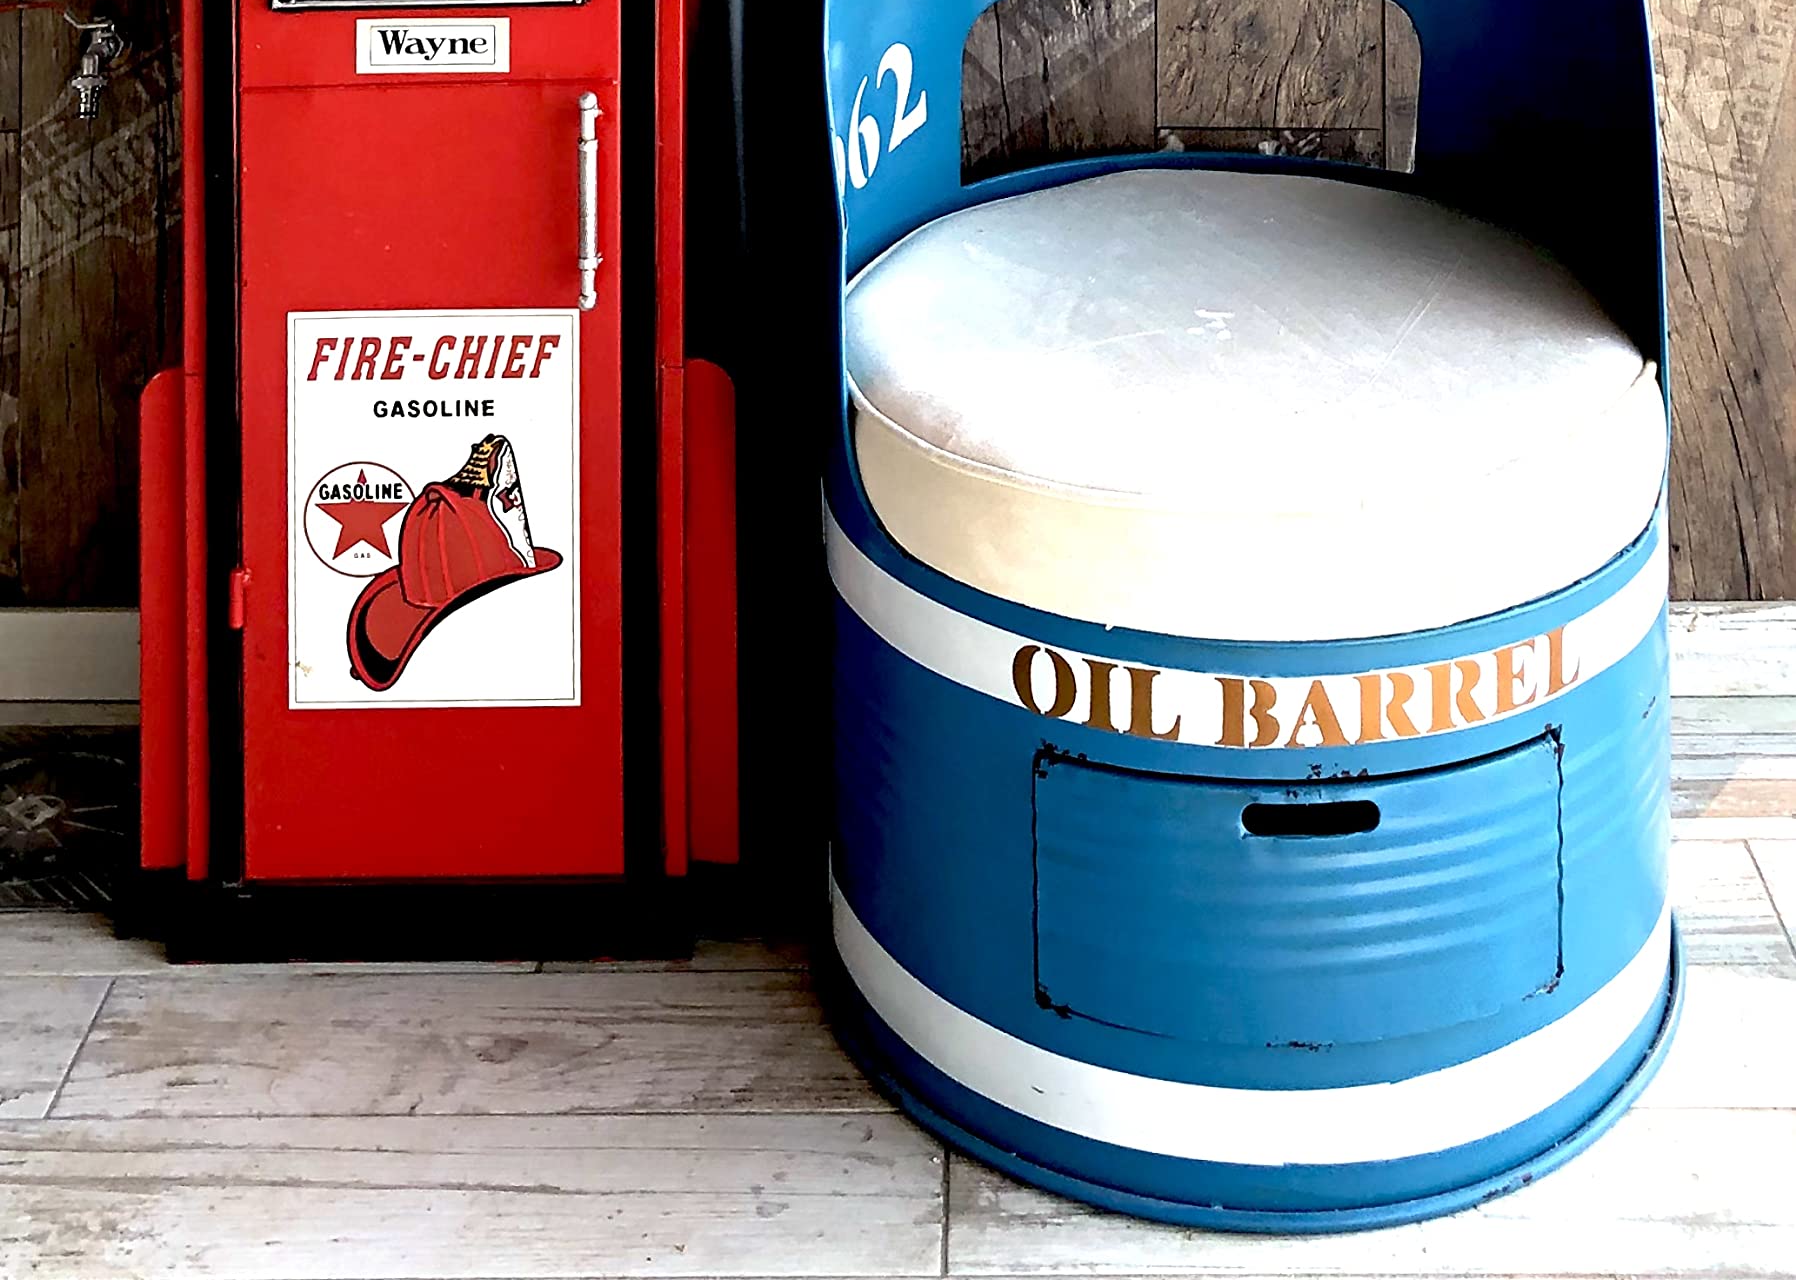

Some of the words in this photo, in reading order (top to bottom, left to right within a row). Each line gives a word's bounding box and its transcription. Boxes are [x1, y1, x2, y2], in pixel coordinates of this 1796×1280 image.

[378, 29, 488, 61] Wayne
[308, 334, 561, 382] FIRE-CHIEF
[373, 399, 495, 418] GASOLINE
[318, 483, 403, 501] GASOLINE
[1012, 644, 1181, 739] OIL
[1215, 625, 1580, 749] BARREL
